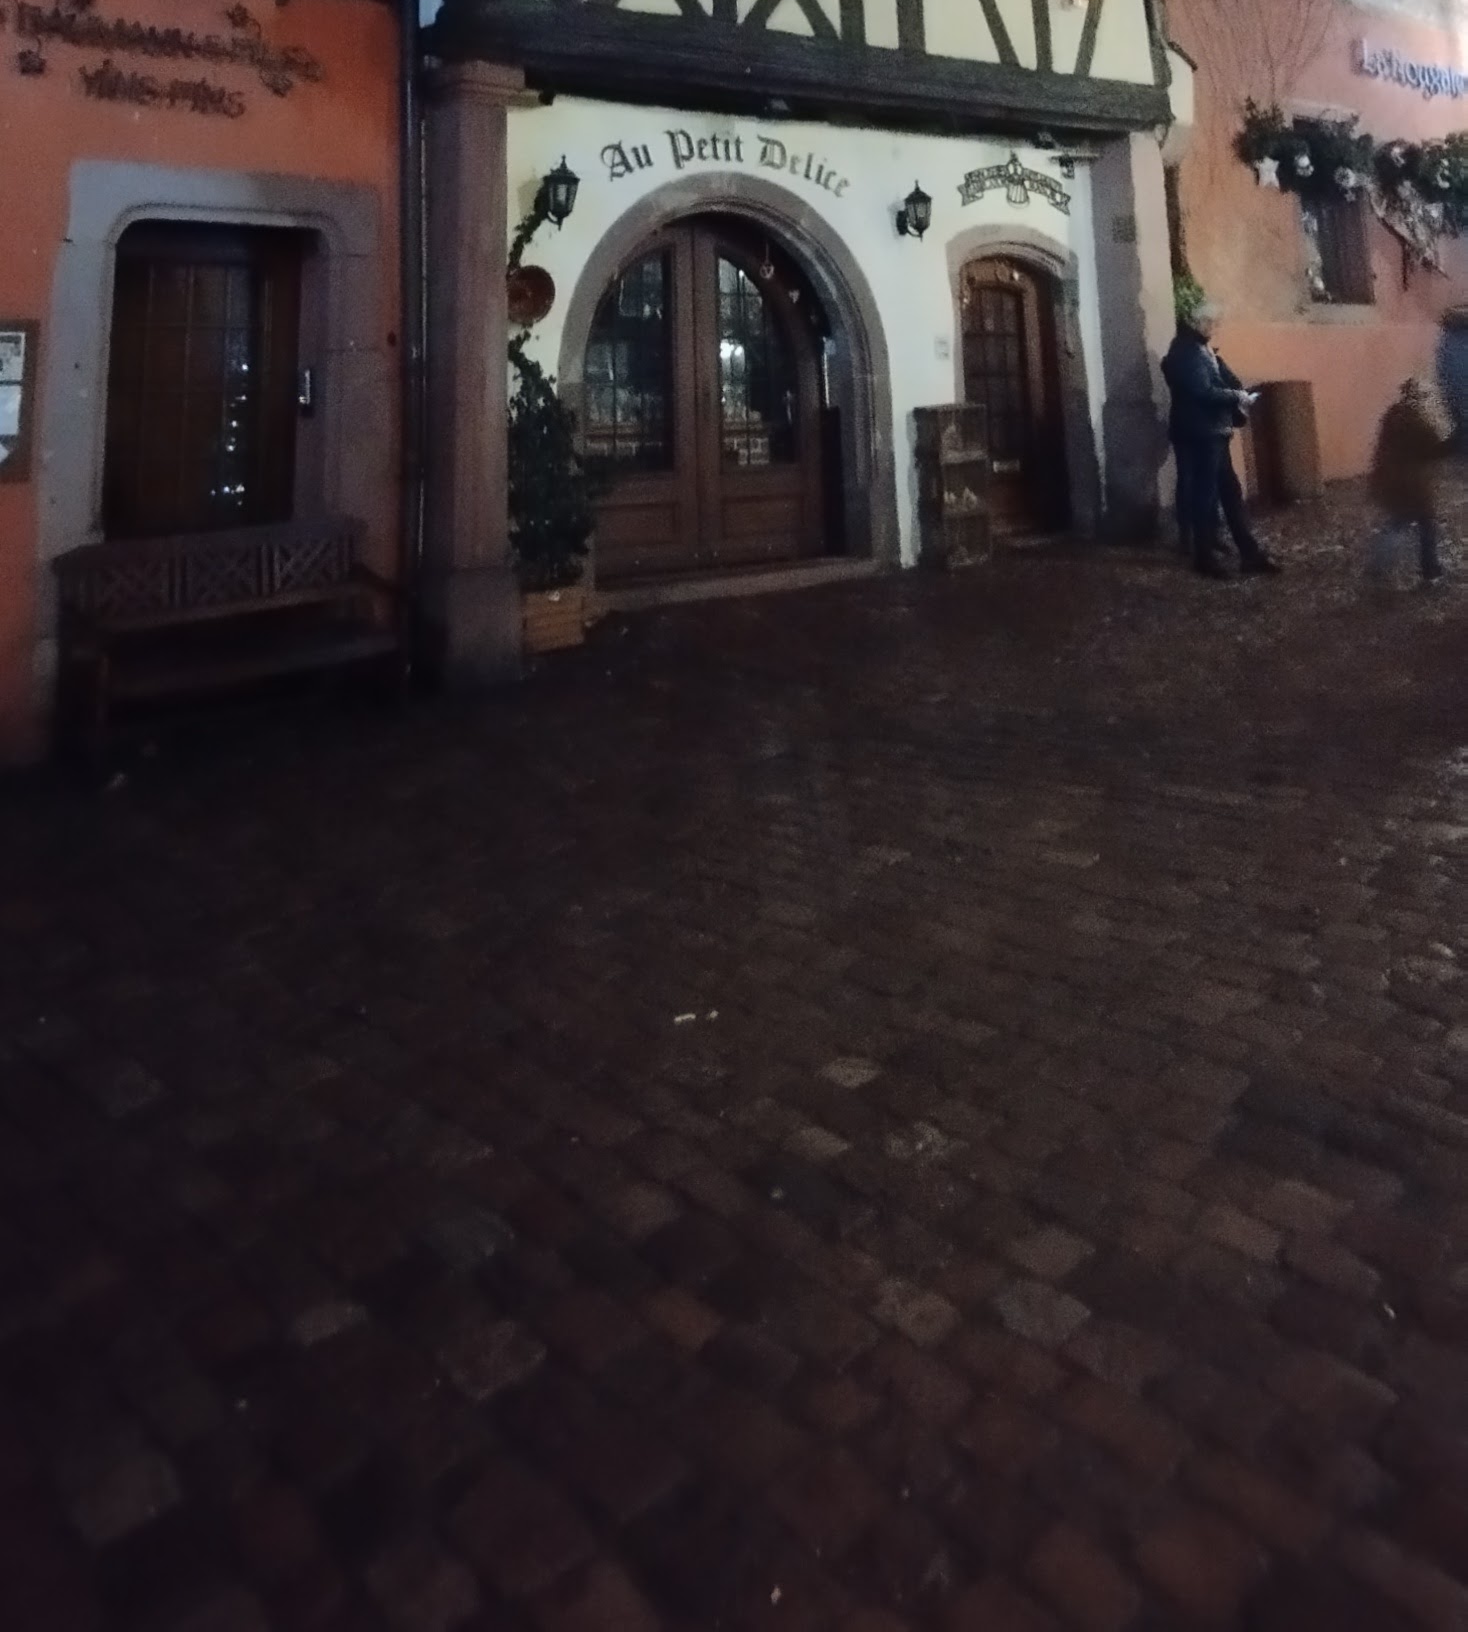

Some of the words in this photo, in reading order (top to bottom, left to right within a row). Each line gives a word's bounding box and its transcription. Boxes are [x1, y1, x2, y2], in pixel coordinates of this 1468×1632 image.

[600, 139, 654, 183] Au
[664, 128, 744, 170] Petit
[756, 134, 851, 198] Delice
